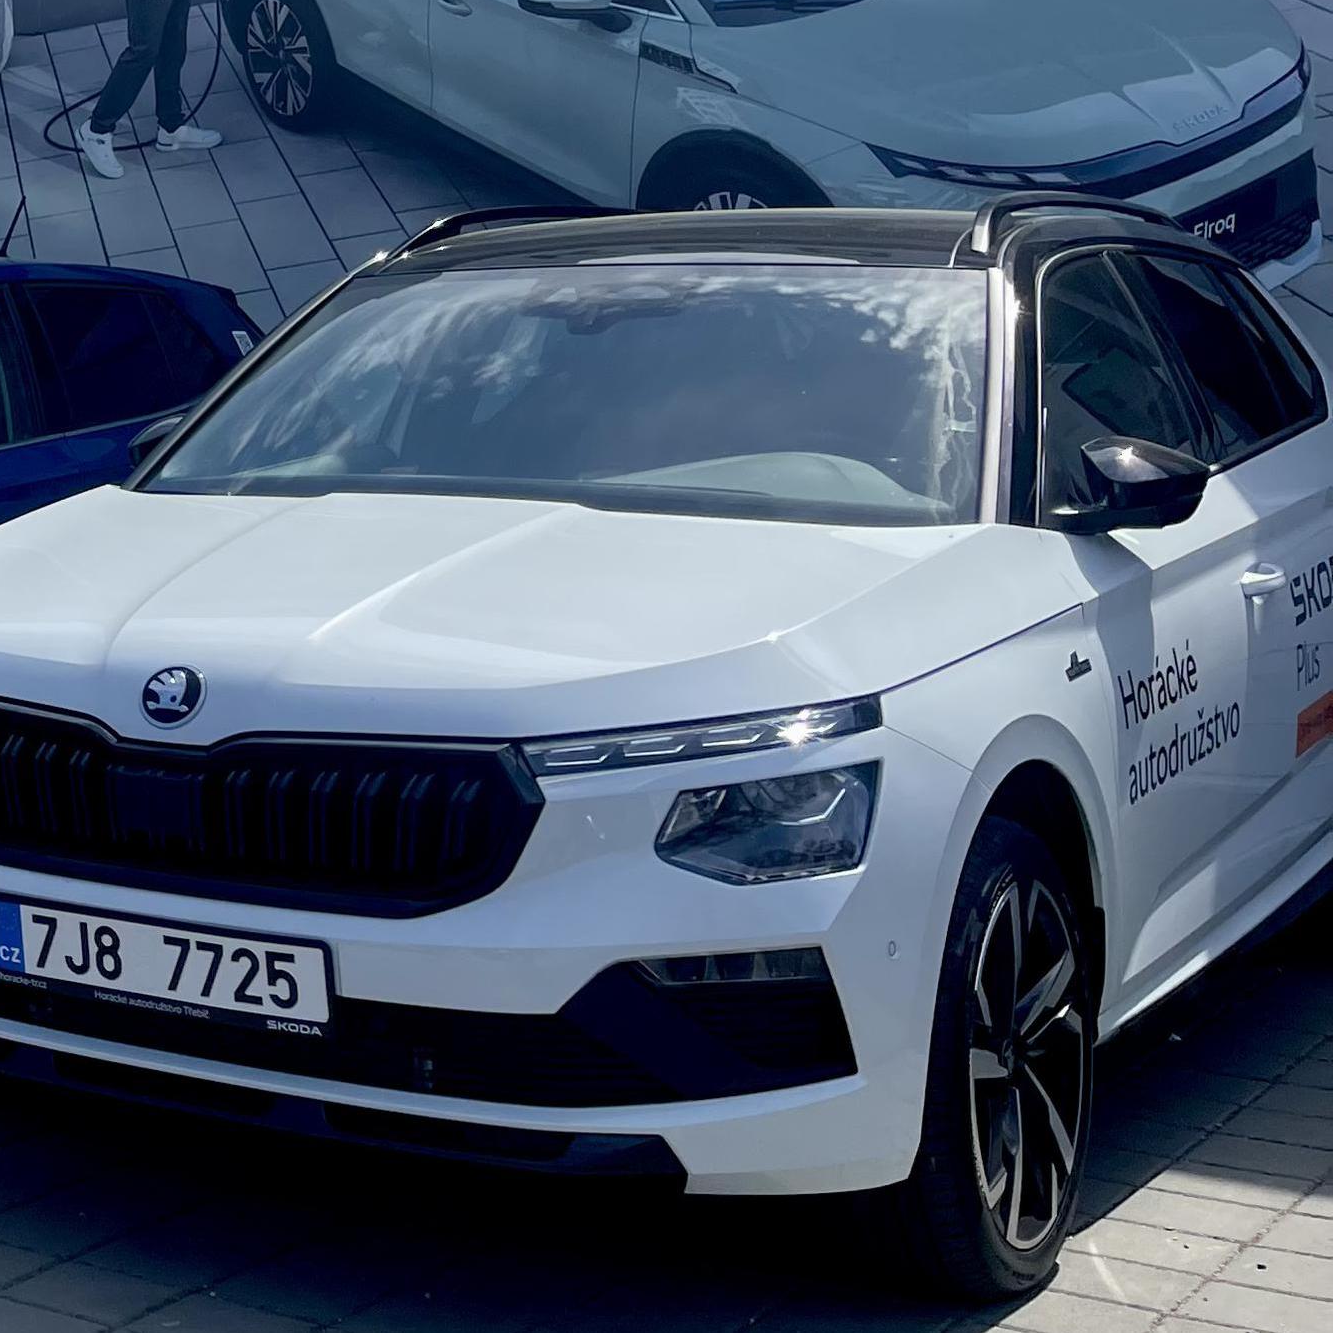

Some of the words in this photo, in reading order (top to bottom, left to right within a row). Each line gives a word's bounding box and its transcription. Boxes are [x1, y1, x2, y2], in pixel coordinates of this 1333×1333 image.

[1194, 214, 1235, 239] Elroq
[1117, 639, 1198, 729] Horácké
[1129, 702, 1240, 805] autodružstvo
[0, 945, 21, 964] CZ
[31, 914, 122, 981] 7J8
[163, 935, 299, 1009] 7725
[266, 1019, 323, 1037] SKODA
